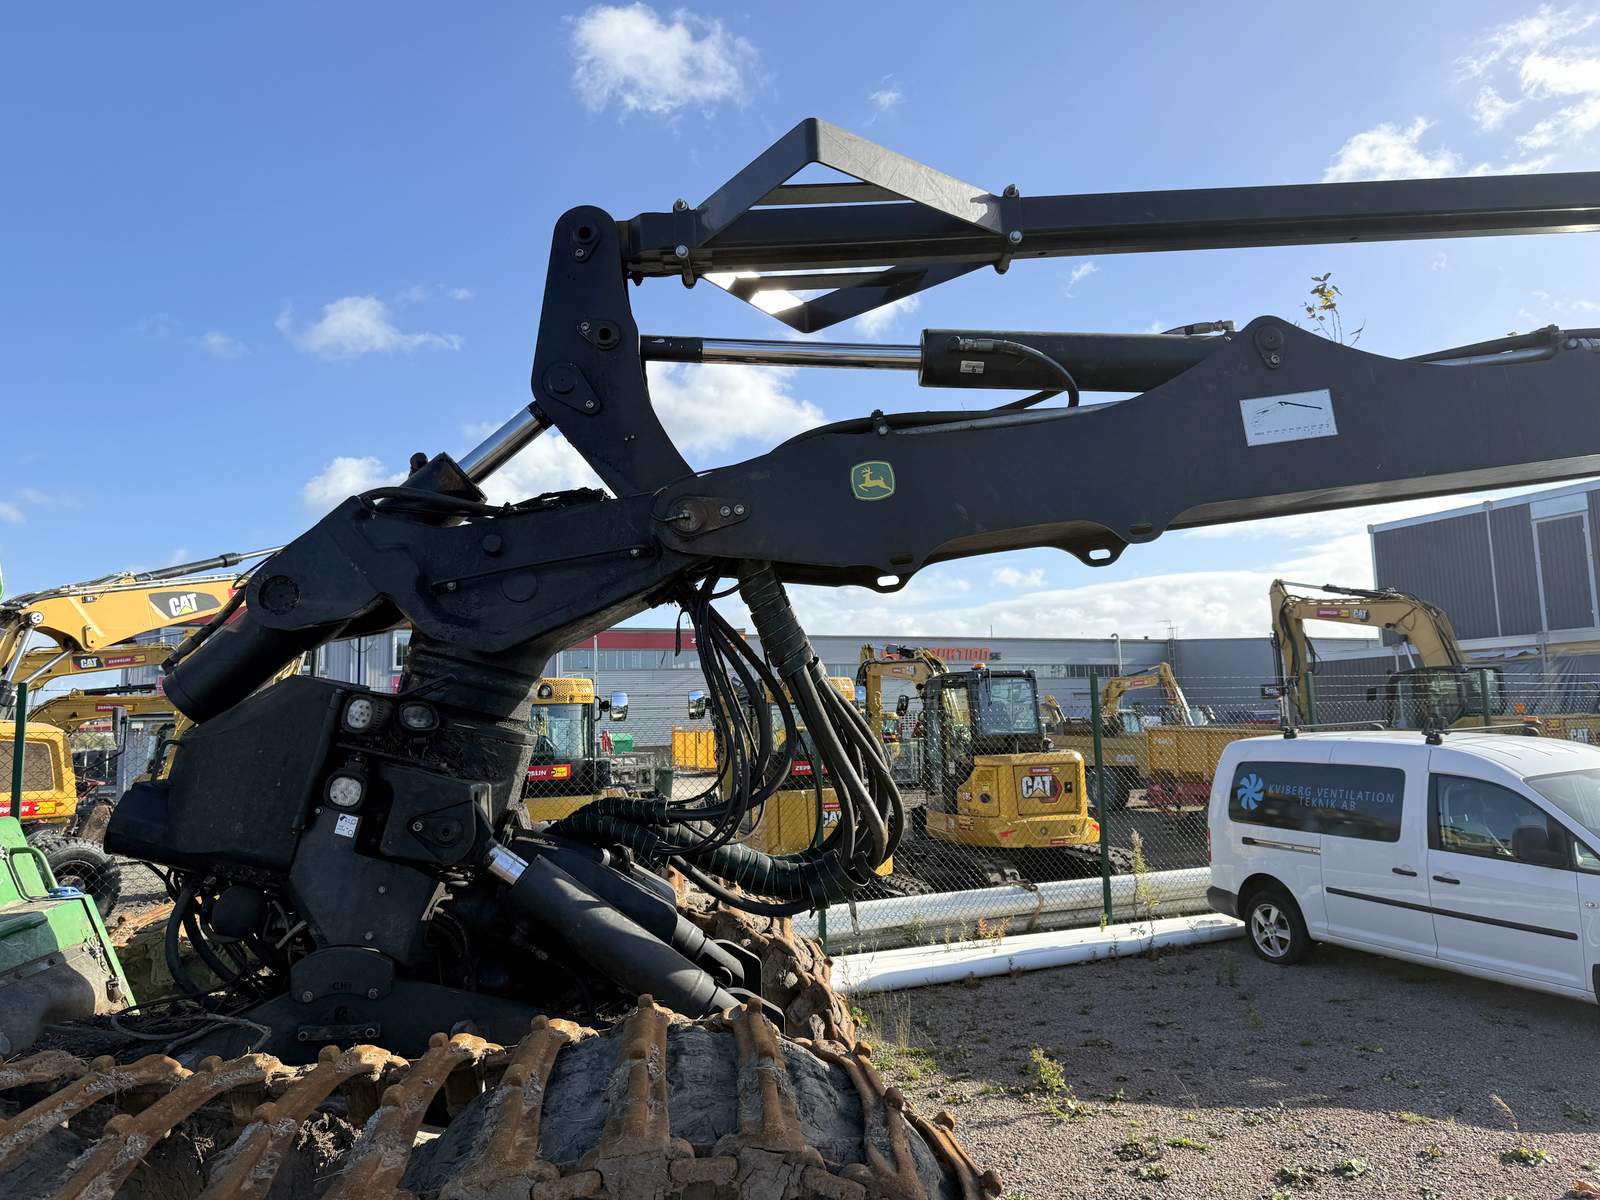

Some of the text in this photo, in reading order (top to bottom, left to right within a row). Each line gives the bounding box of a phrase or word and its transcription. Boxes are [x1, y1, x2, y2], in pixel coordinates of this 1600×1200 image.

[168, 593, 198, 616] CAT
[80, 658, 98, 669] CAT
[1021, 775, 1052, 799] CAT
[1268, 783, 1394, 804] KVIBERG VENTILATION
[1299, 796, 1356, 811] TEKNIK AB
